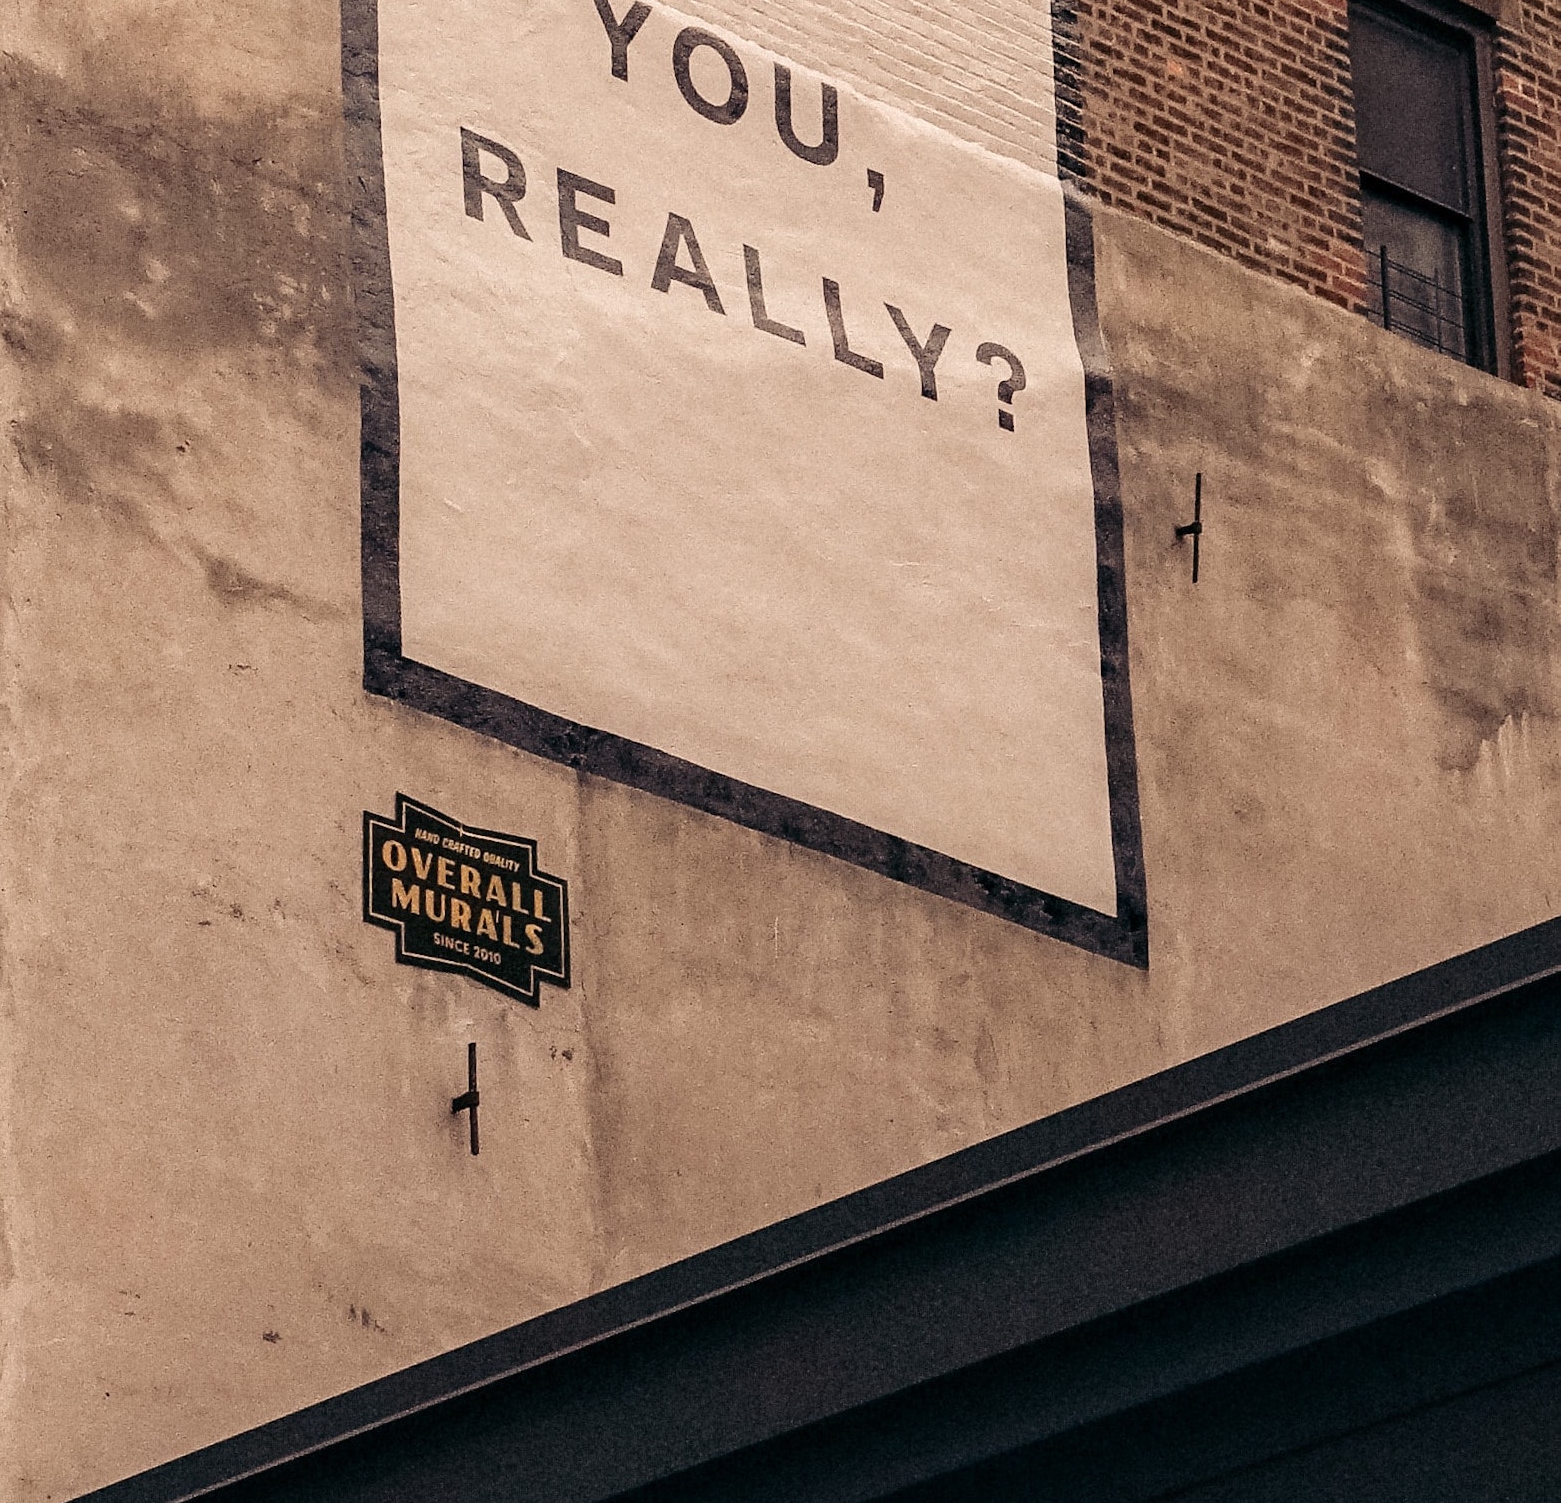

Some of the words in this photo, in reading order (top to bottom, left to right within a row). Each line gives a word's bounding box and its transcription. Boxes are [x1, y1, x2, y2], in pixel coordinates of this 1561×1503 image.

[459, 126, 1028, 433] REALLY?
[381, 839, 552, 923] OVERALL
[414, 828, 440, 845] HAND
[442, 838, 481, 859] CRAFTED
[483, 852, 520, 873] QUALITY
[391, 877, 545, 956] MURALS
[433, 932, 470, 955] SINCE
[473, 946, 502, 965] 2010
